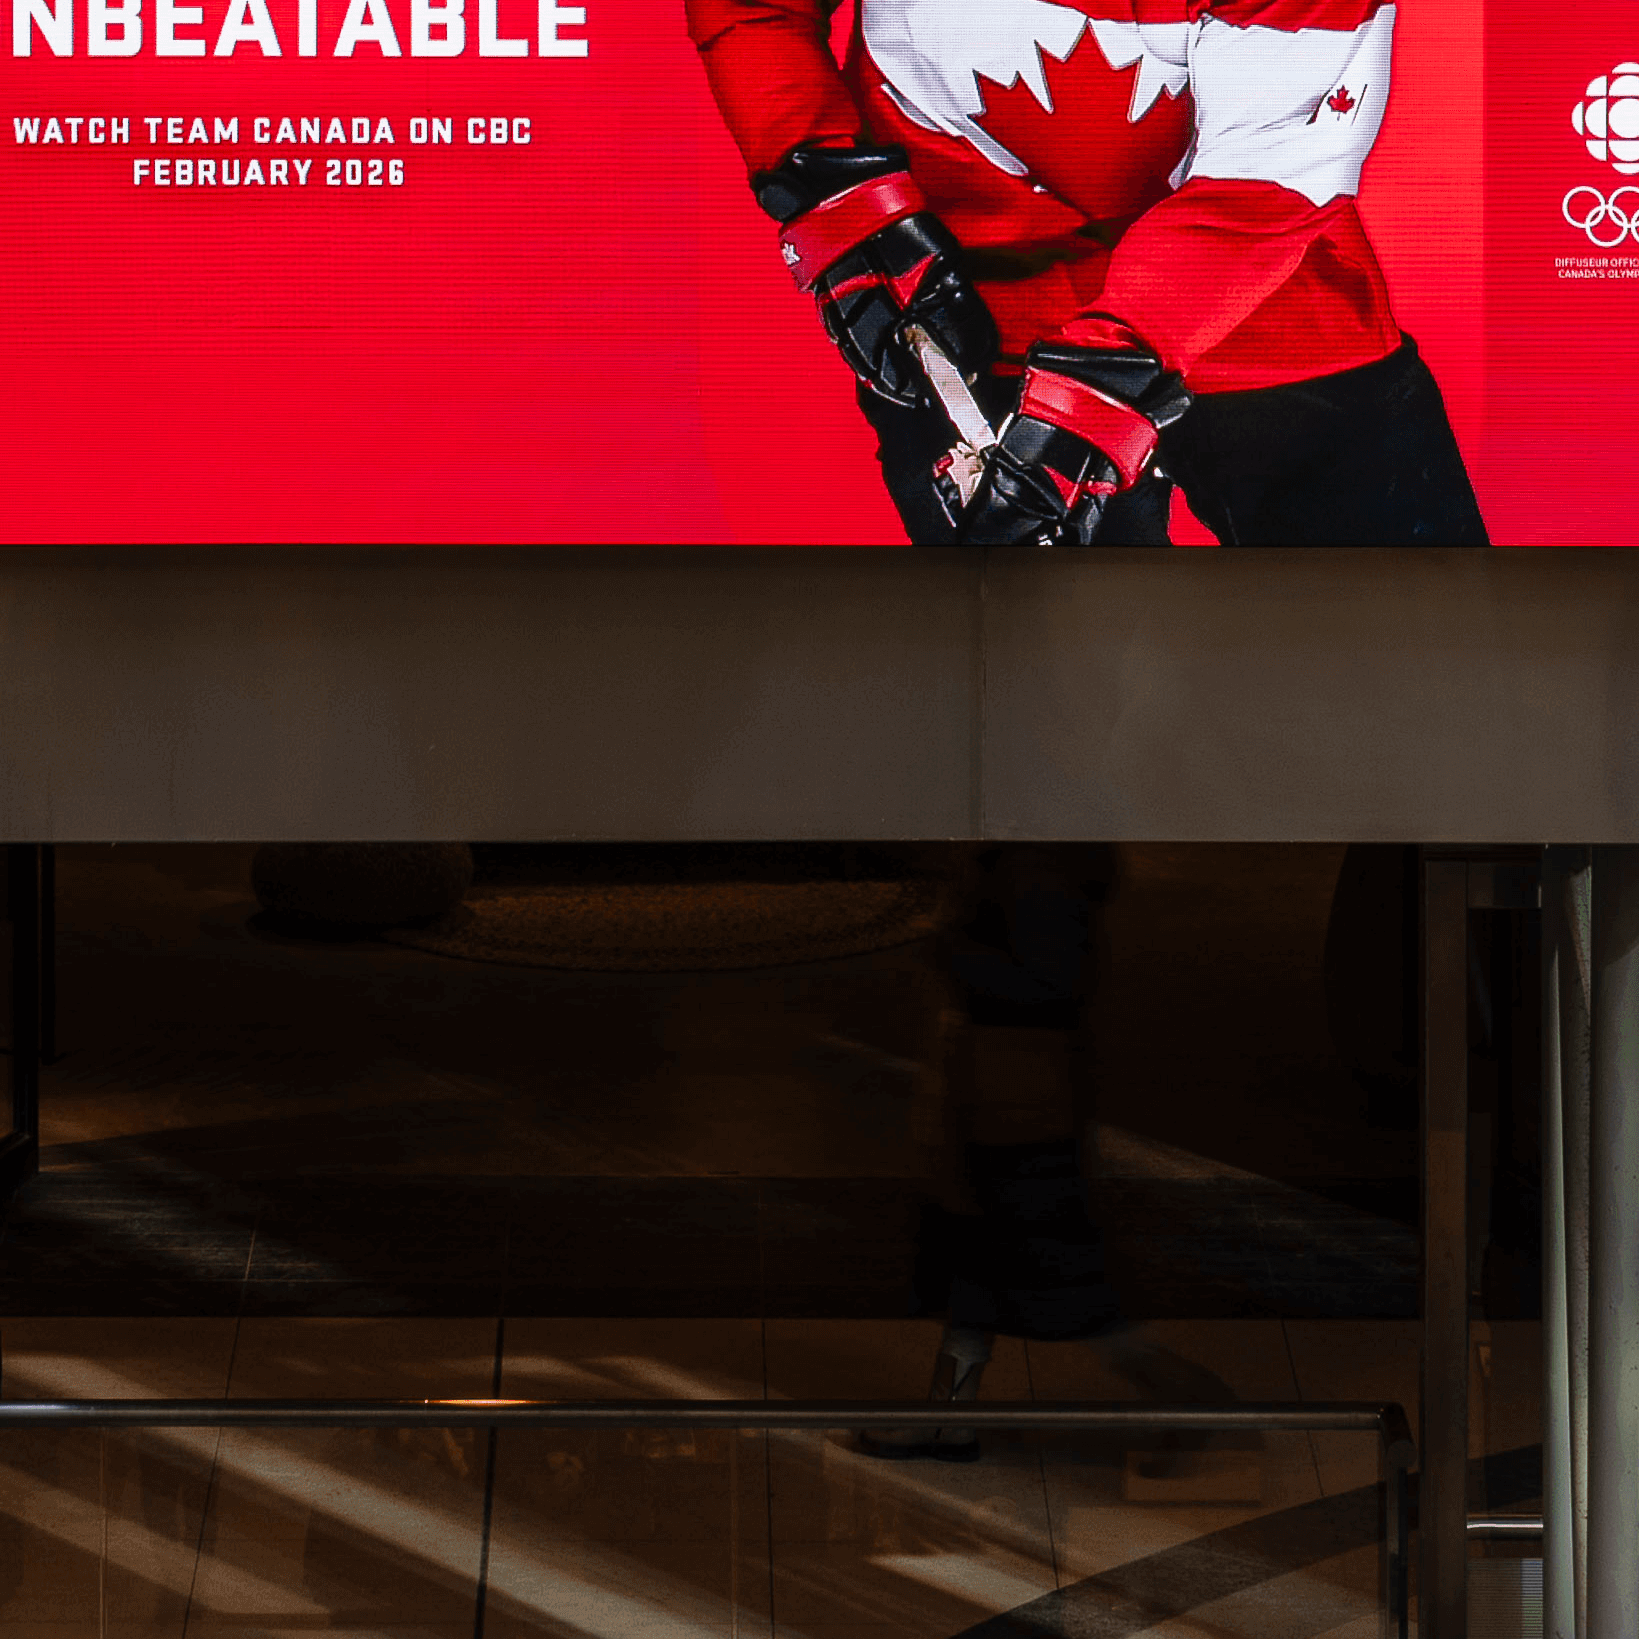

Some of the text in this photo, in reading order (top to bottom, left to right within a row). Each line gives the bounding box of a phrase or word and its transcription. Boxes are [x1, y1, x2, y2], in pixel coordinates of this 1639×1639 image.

[12, 116, 532, 145] WATCH TEAM CANADA ON CBC
[132, 158, 405, 187] FEBRUARY 2026
[1554, 257, 1609, 268] DIFFUSEUR
[1557, 268, 1606, 279] CANADA'S
